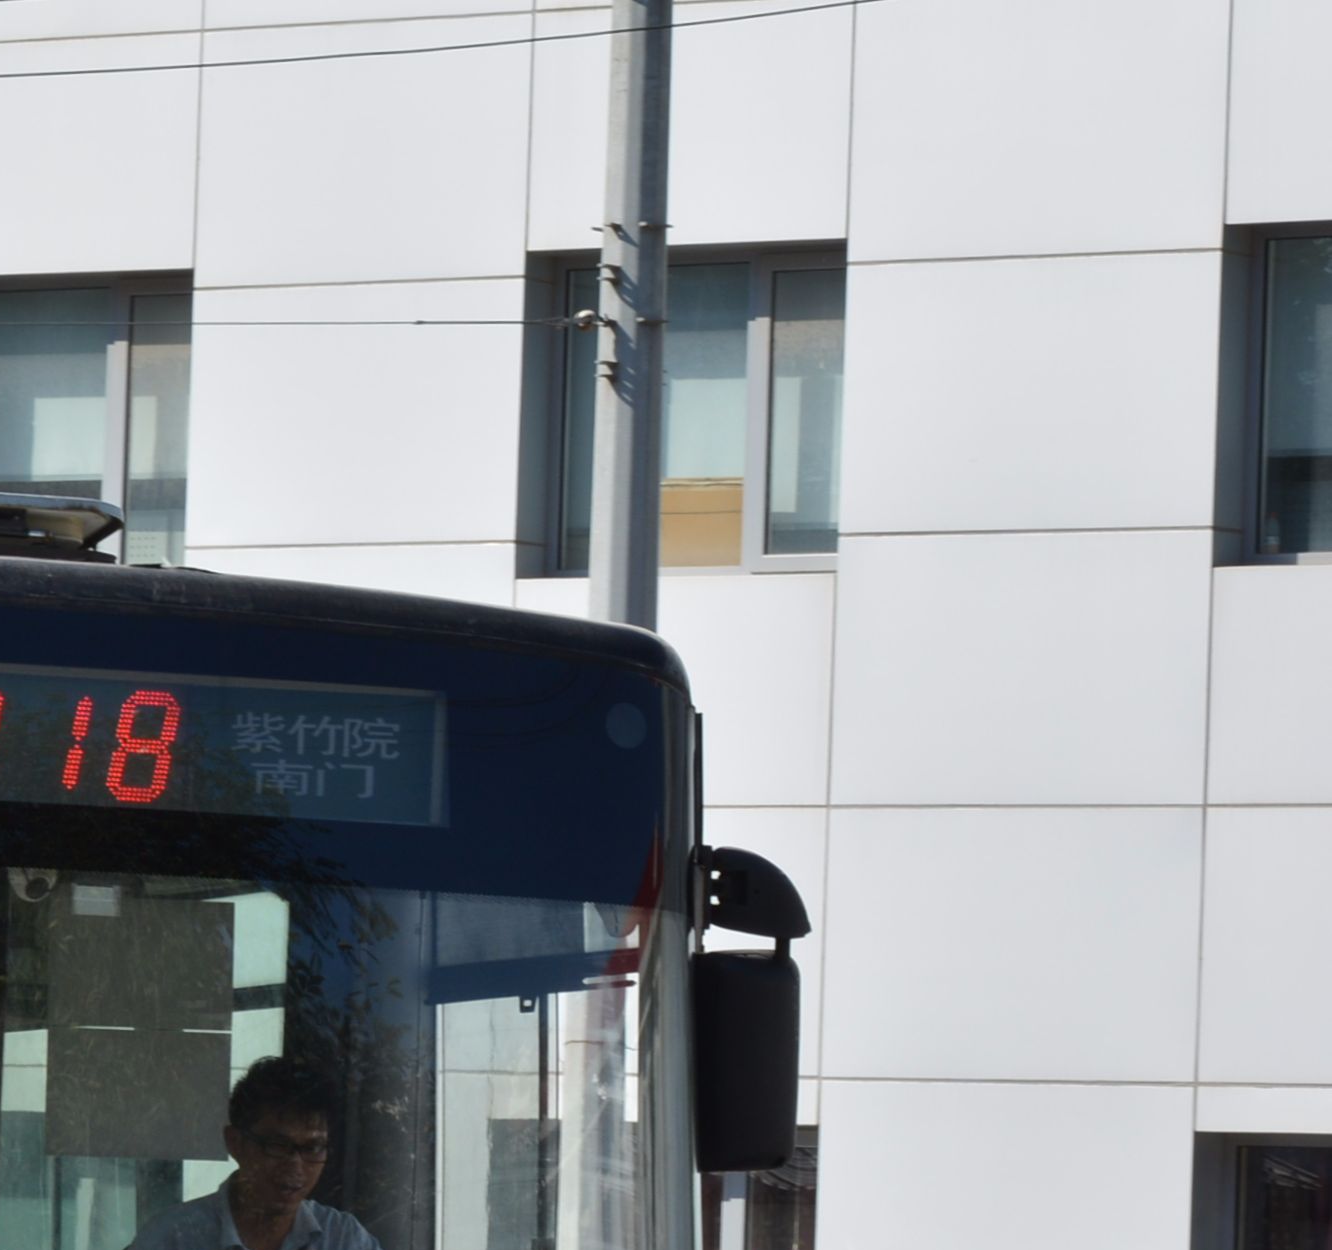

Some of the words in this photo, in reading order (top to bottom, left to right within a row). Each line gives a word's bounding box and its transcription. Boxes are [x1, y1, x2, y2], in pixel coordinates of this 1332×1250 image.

[232, 711, 402, 760] 紫竹院
[253, 762, 377, 799] 南门
